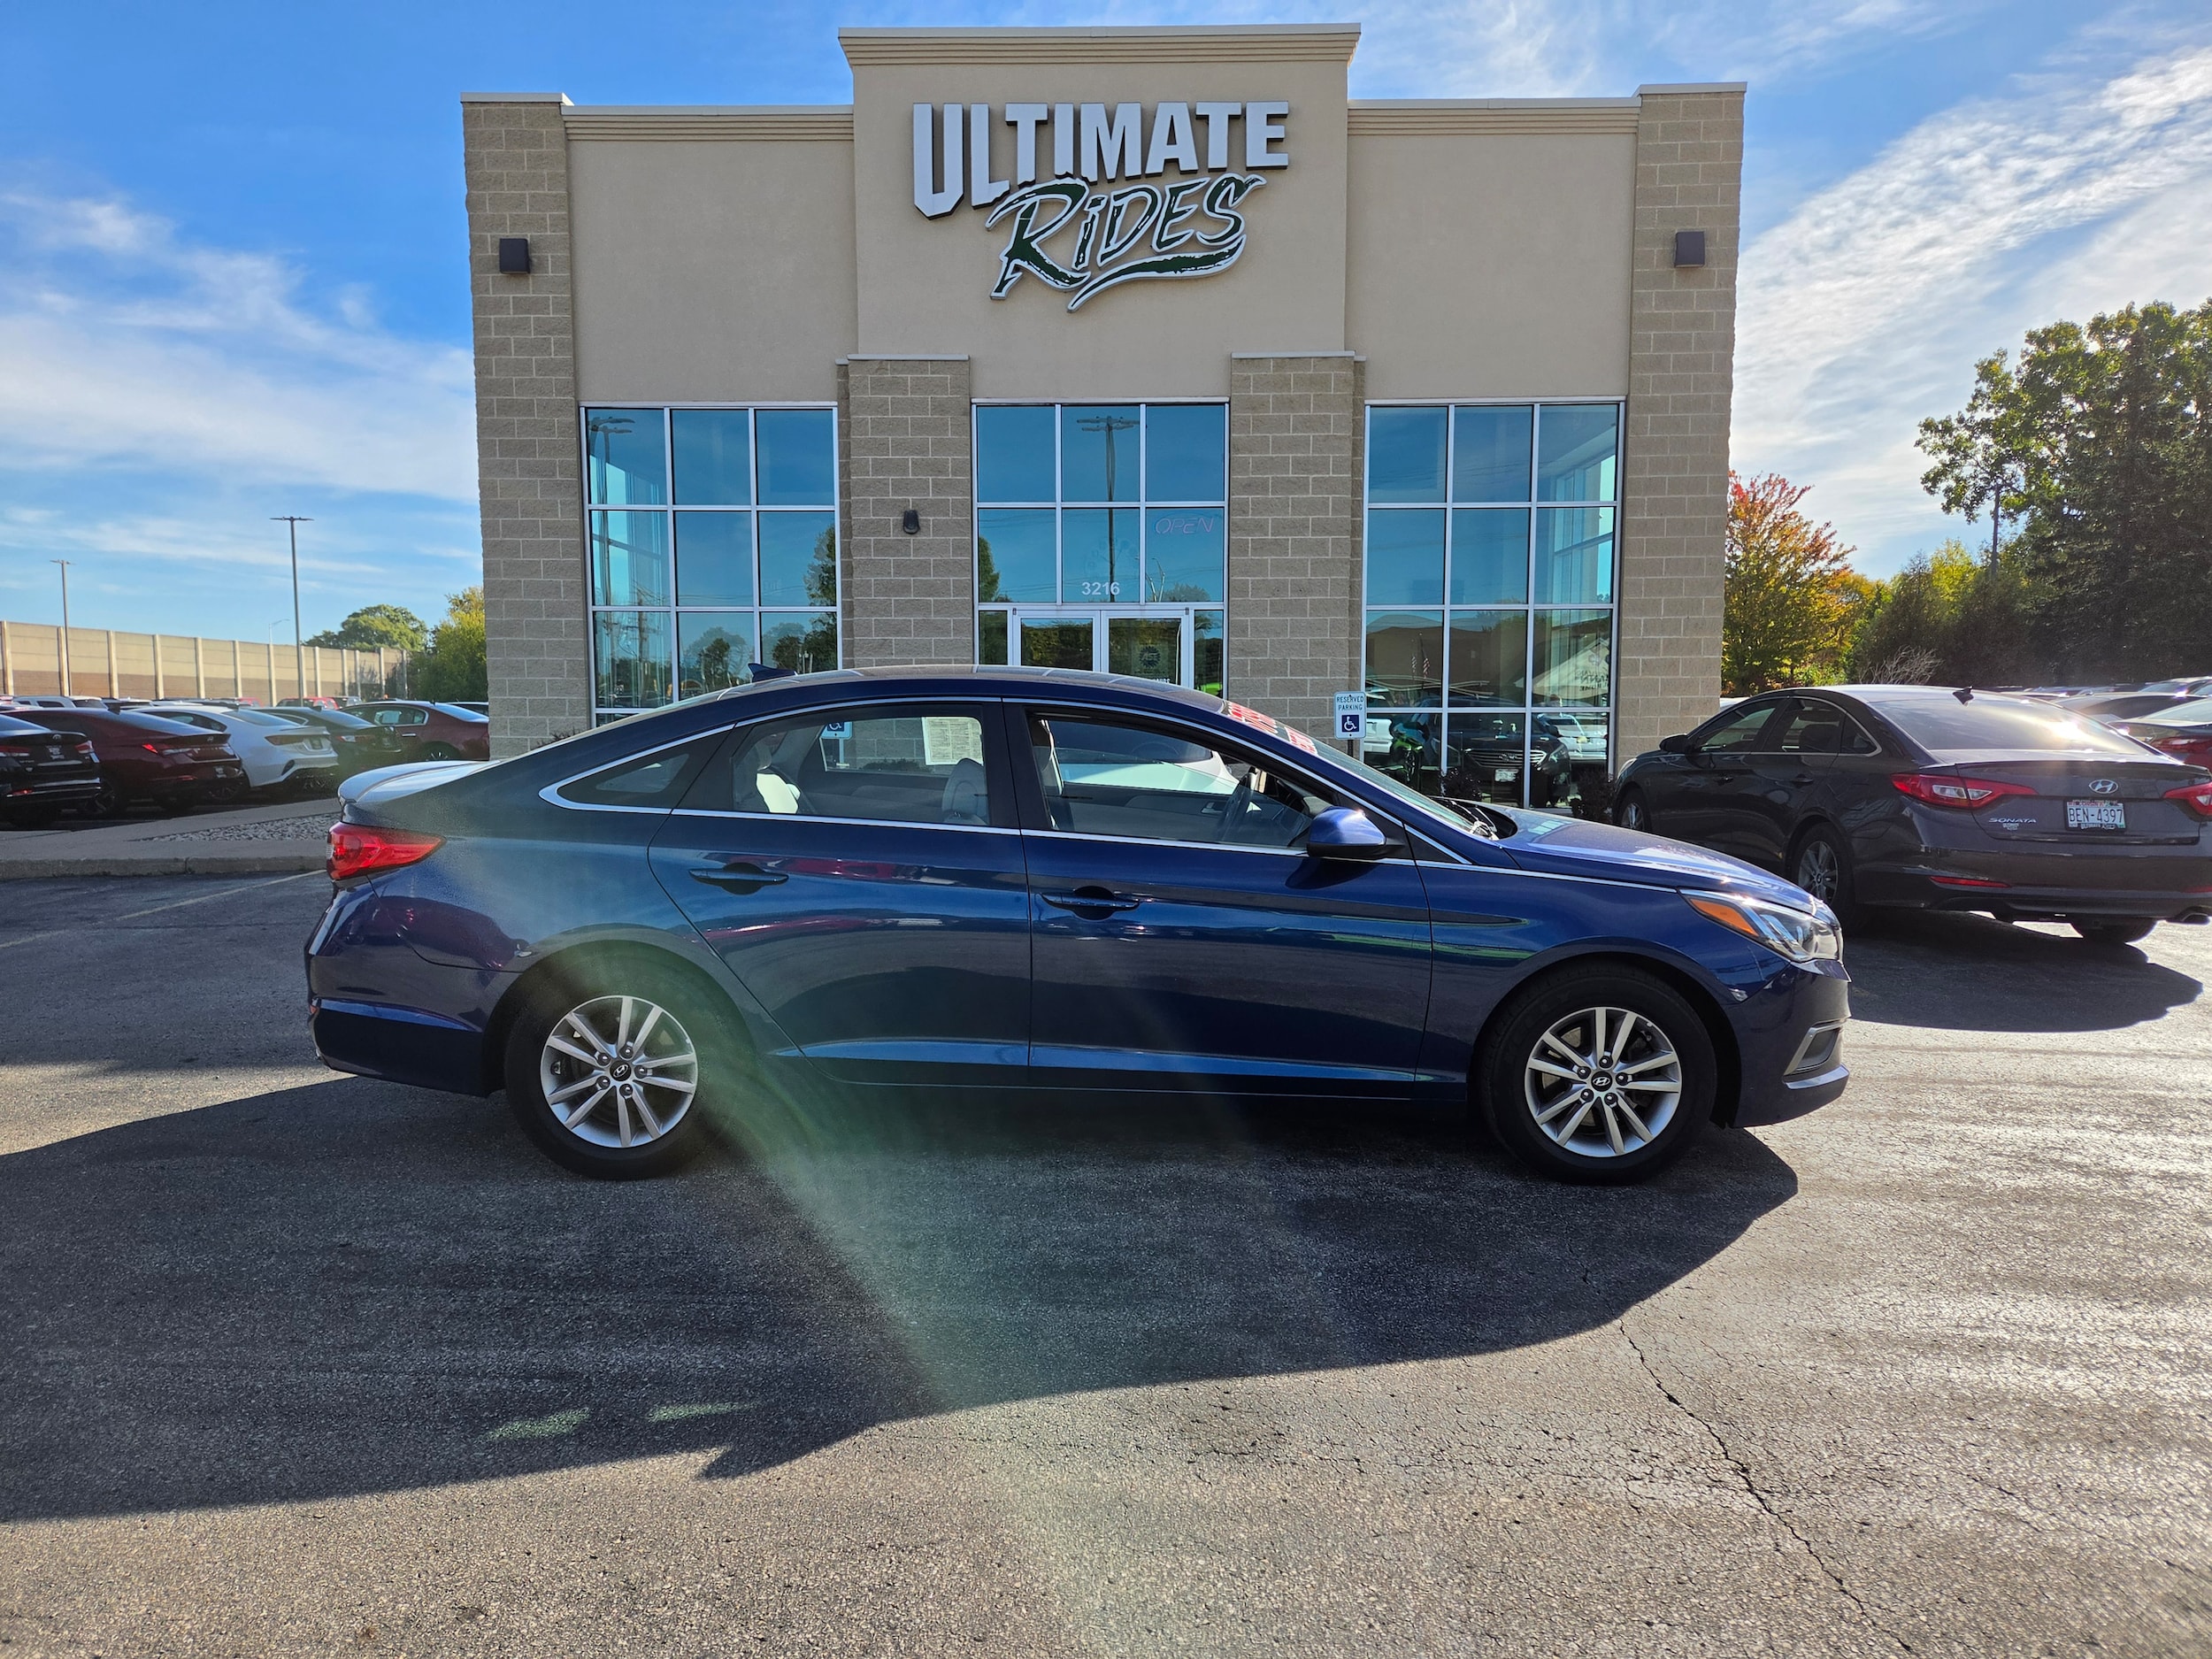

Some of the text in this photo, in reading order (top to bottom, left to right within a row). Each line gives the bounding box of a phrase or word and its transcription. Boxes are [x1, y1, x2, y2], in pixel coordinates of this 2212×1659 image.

[913, 101, 1289, 219] ULTIMATE
[1155, 517, 1215, 534] OPEN
[1081, 581, 1121, 596] 3216
[2069, 808, 2123, 823] BEN-4397
